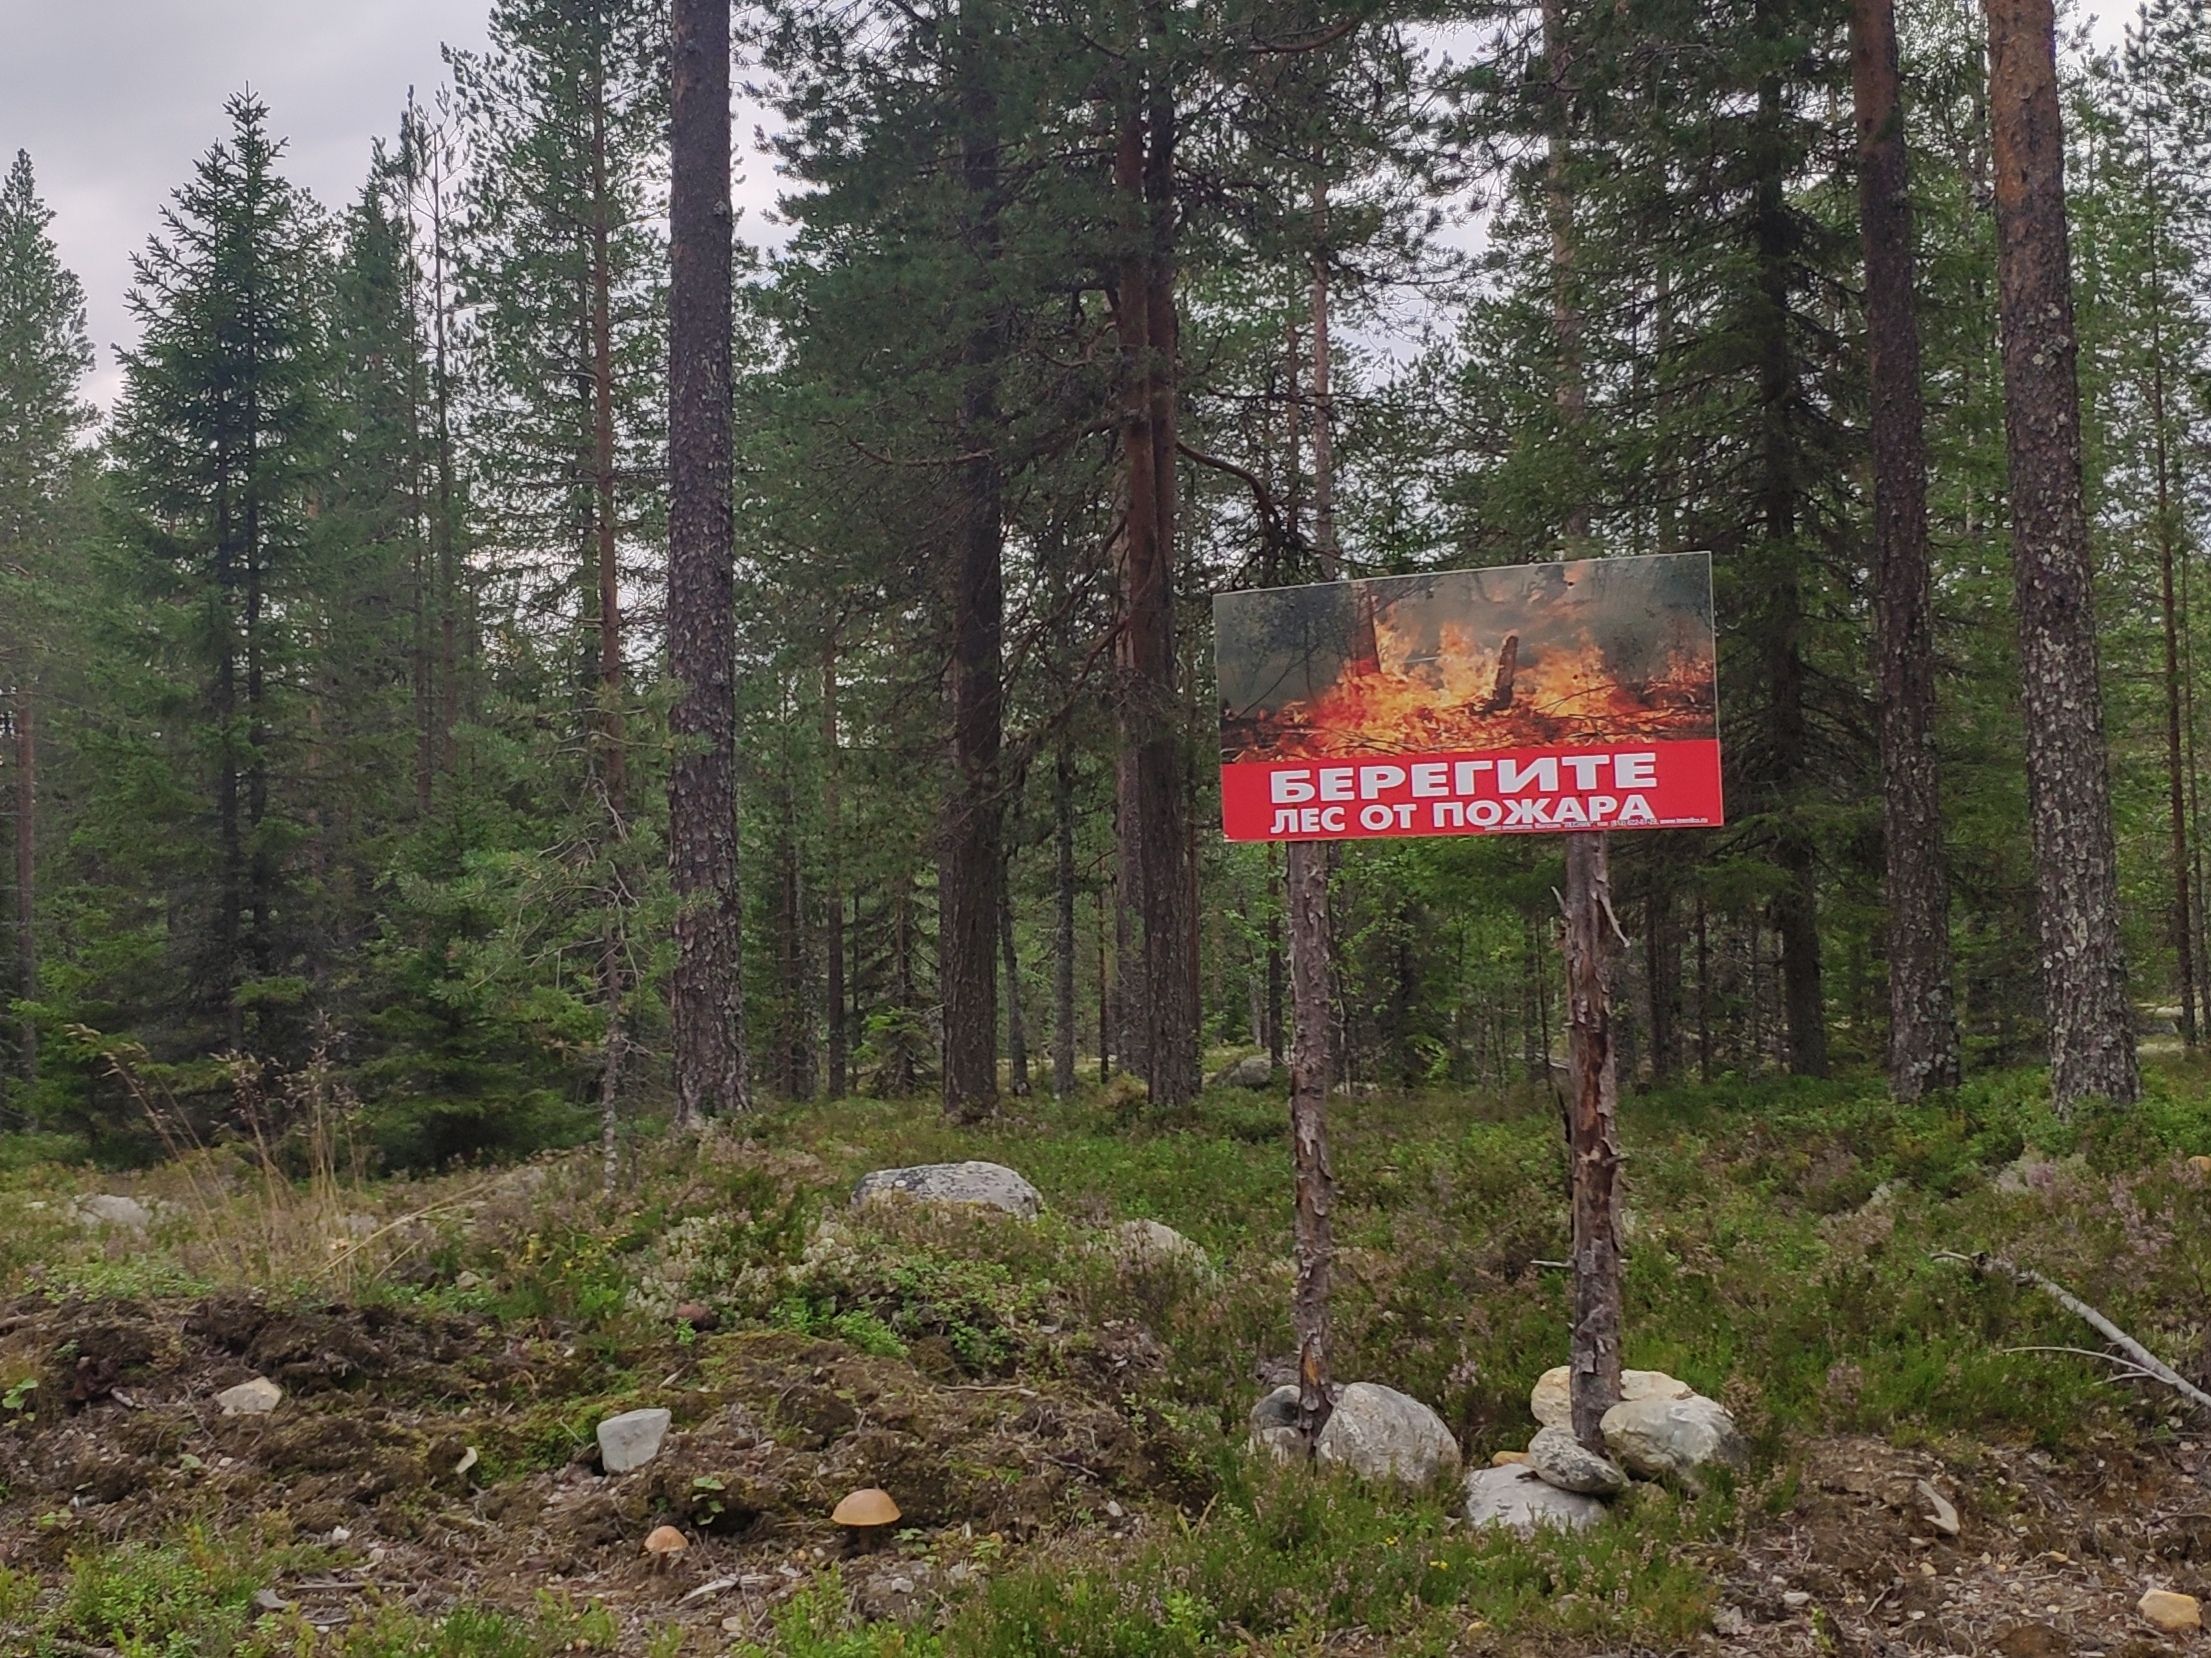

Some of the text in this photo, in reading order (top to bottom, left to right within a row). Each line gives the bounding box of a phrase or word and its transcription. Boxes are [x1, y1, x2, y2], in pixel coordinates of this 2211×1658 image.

[1270, 753, 1657, 803] БЕРЕГИТЕ
[1270, 807, 1345, 834] ЛЕС
[1360, 804, 1417, 831] ОТ
[1433, 795, 1656, 828] ПОЖАРА
